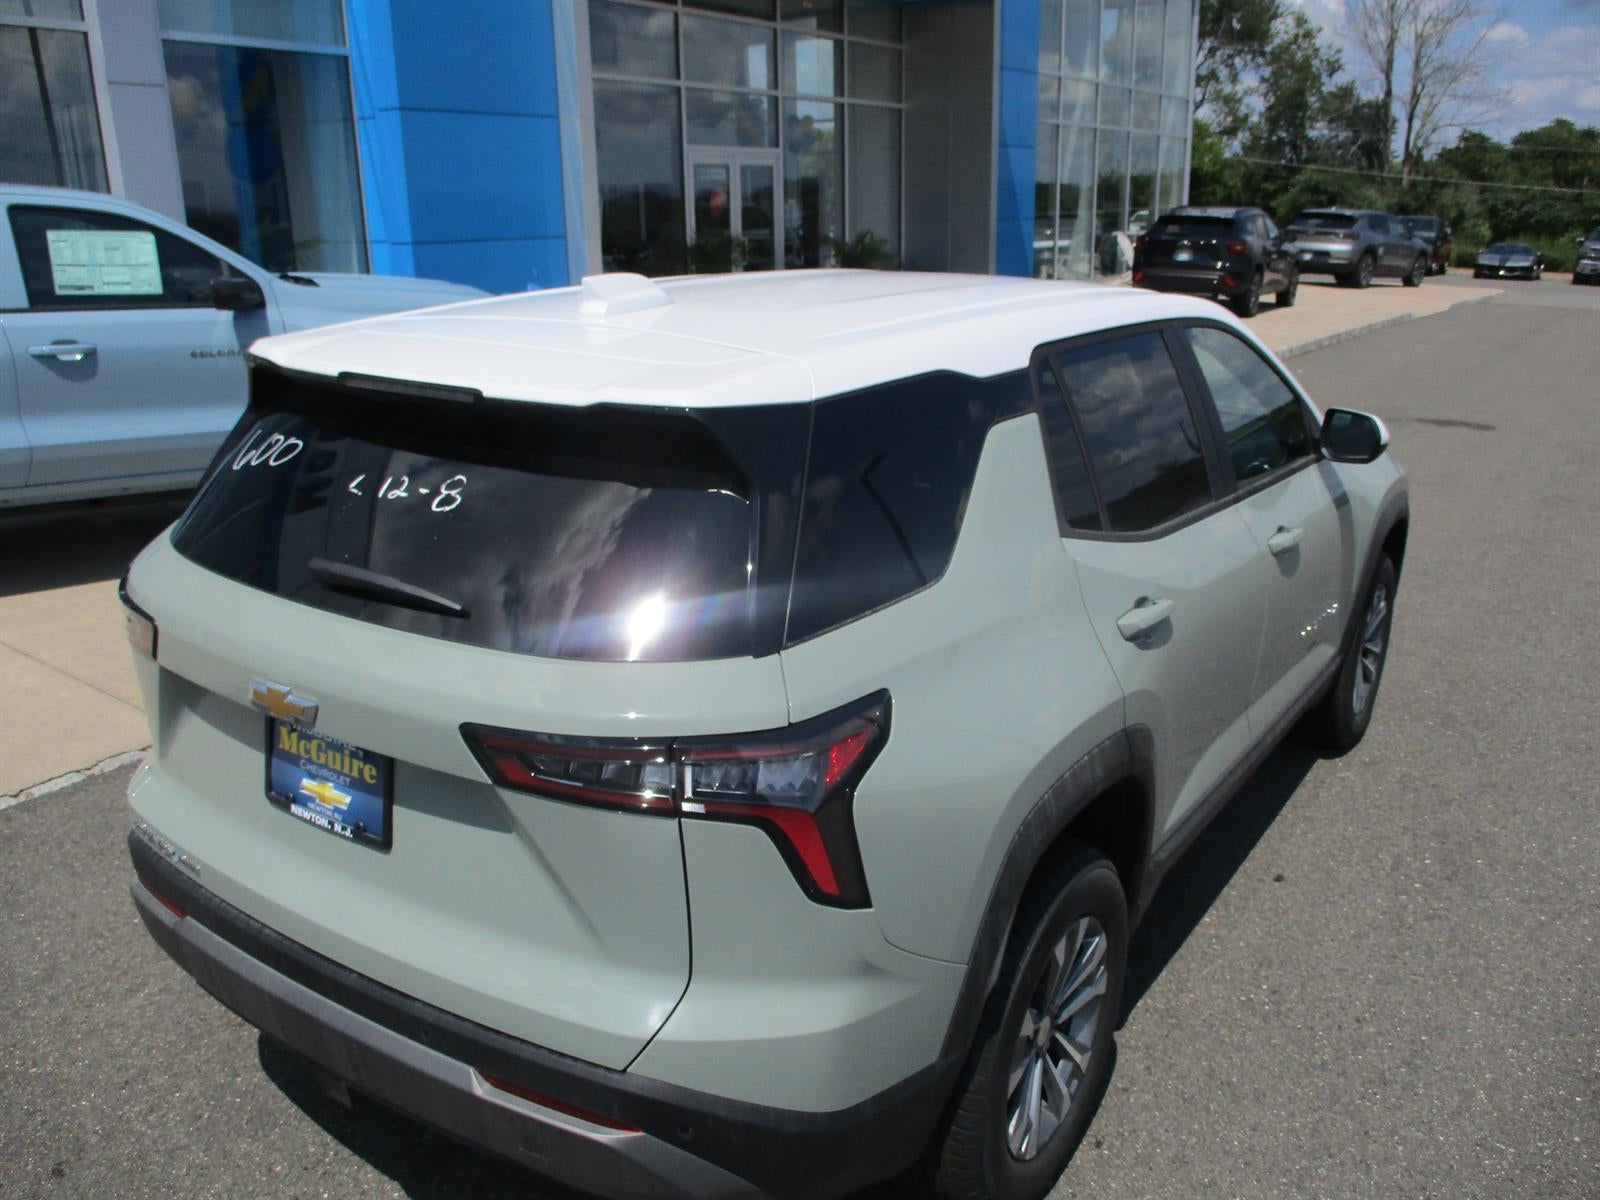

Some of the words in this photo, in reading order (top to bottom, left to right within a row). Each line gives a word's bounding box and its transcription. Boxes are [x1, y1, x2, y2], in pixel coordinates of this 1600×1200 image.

[278, 725, 377, 784] McGuire
[299, 759, 352, 786] CHEVROLET
[290, 803, 332, 829] NEWTON,
[333, 822, 353, 838] N.J.
